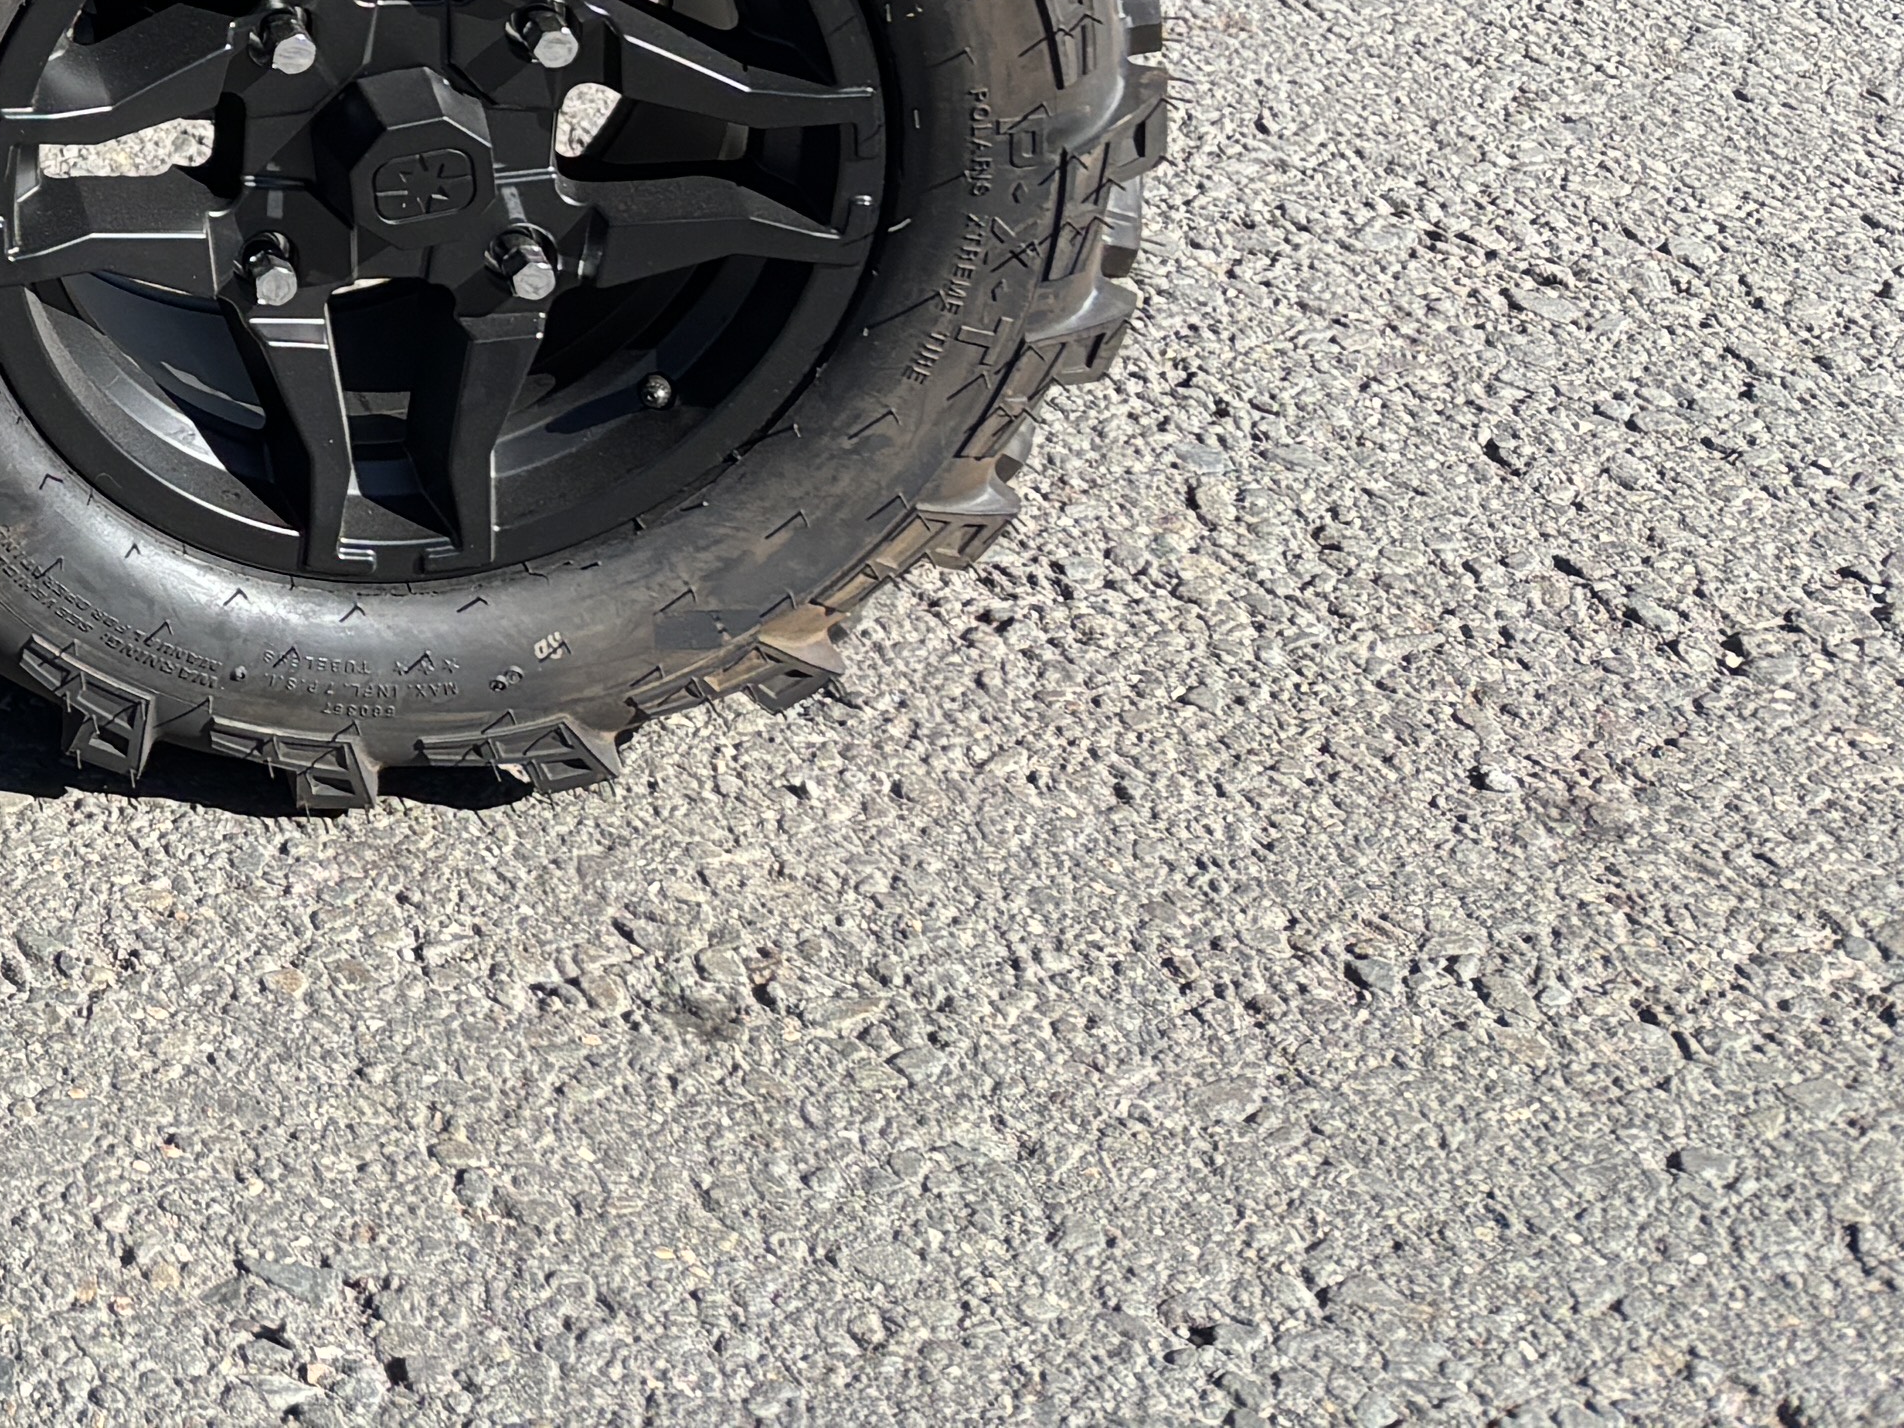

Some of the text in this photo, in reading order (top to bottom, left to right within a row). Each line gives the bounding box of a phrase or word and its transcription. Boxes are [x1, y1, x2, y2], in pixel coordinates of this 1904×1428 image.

[900, 85, 994, 388] POLARIS XTREME TIRE
[96, 629, 221, 690] WARNING:
[339, 679, 398, 698] INFL.
[404, 679, 459, 698] MAX.
